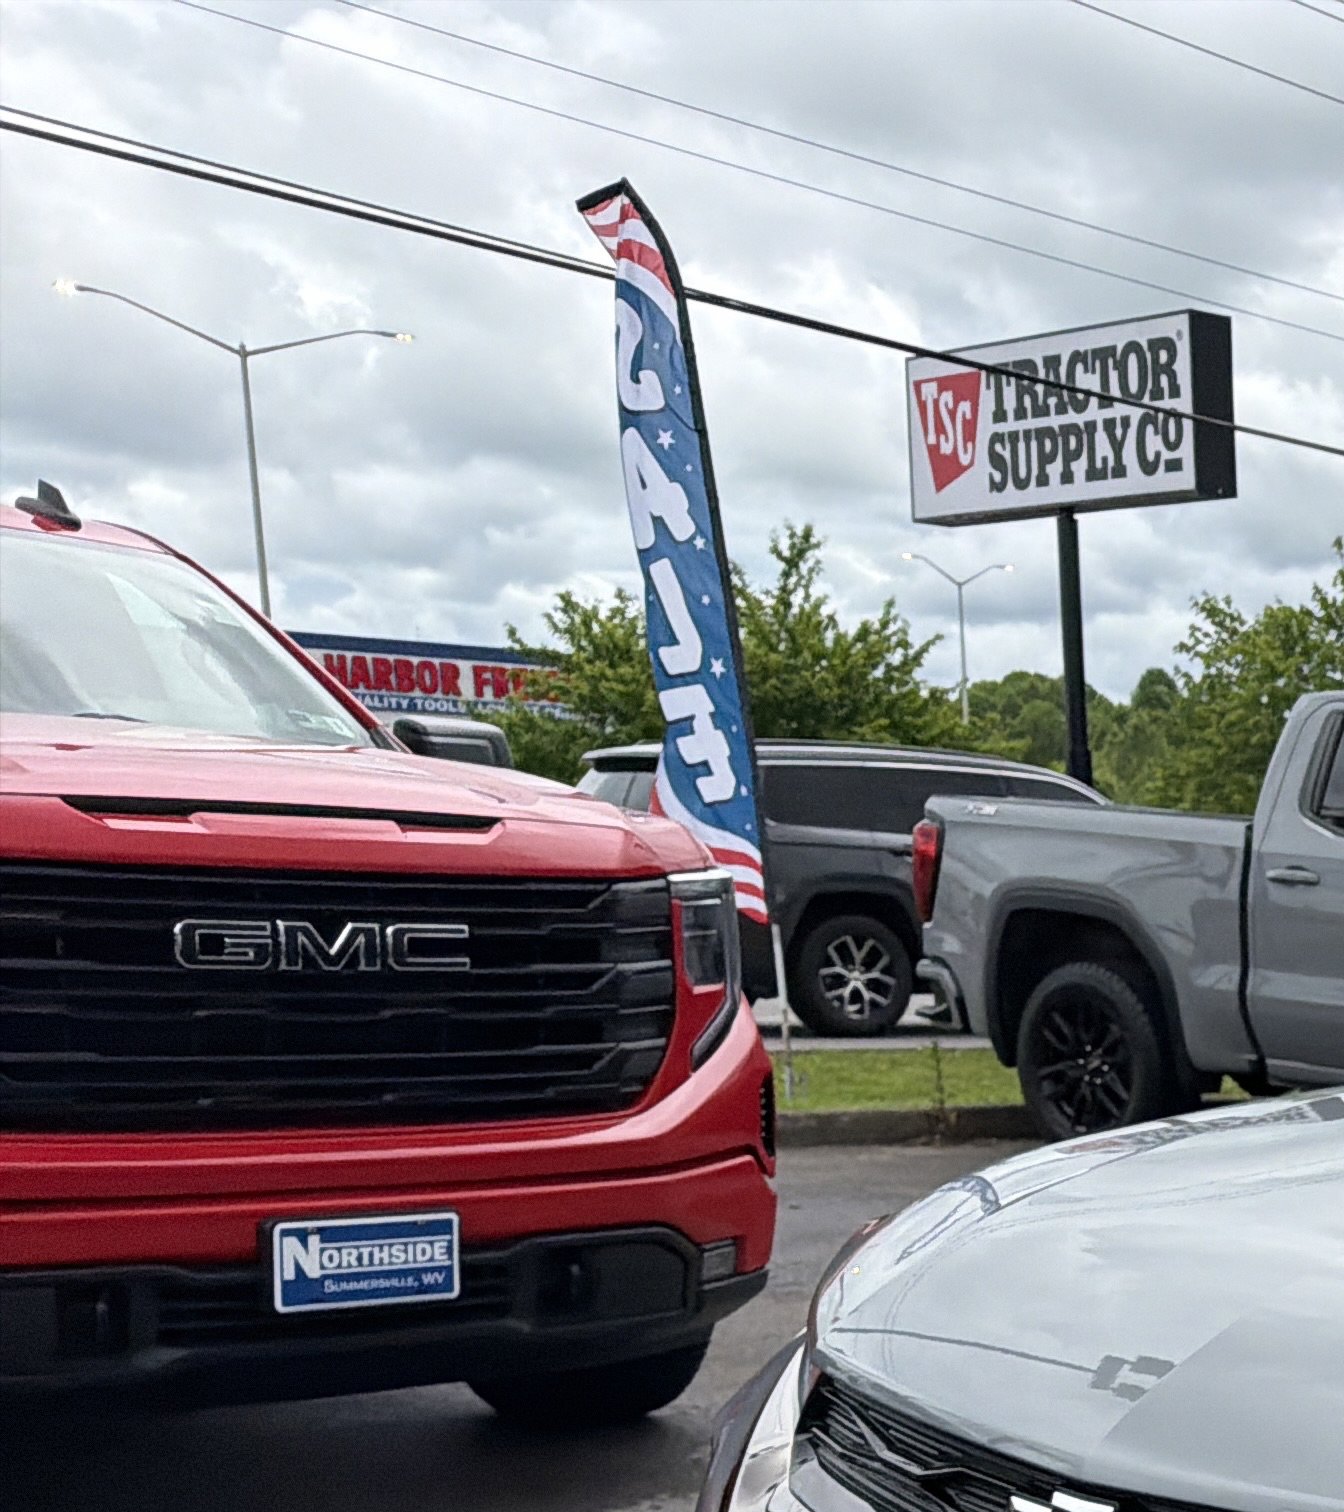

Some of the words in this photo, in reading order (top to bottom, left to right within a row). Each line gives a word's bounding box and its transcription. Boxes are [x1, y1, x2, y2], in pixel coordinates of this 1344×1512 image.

[984, 336, 1182, 424] TRACTOR
[920, 381, 973, 467] TSC
[987, 414, 1131, 494] SUPPLY
[323, 653, 462, 697] HARBOR
[174, 919, 471, 972] GMC
[282, 1234, 449, 1280] NORTHSIDE
